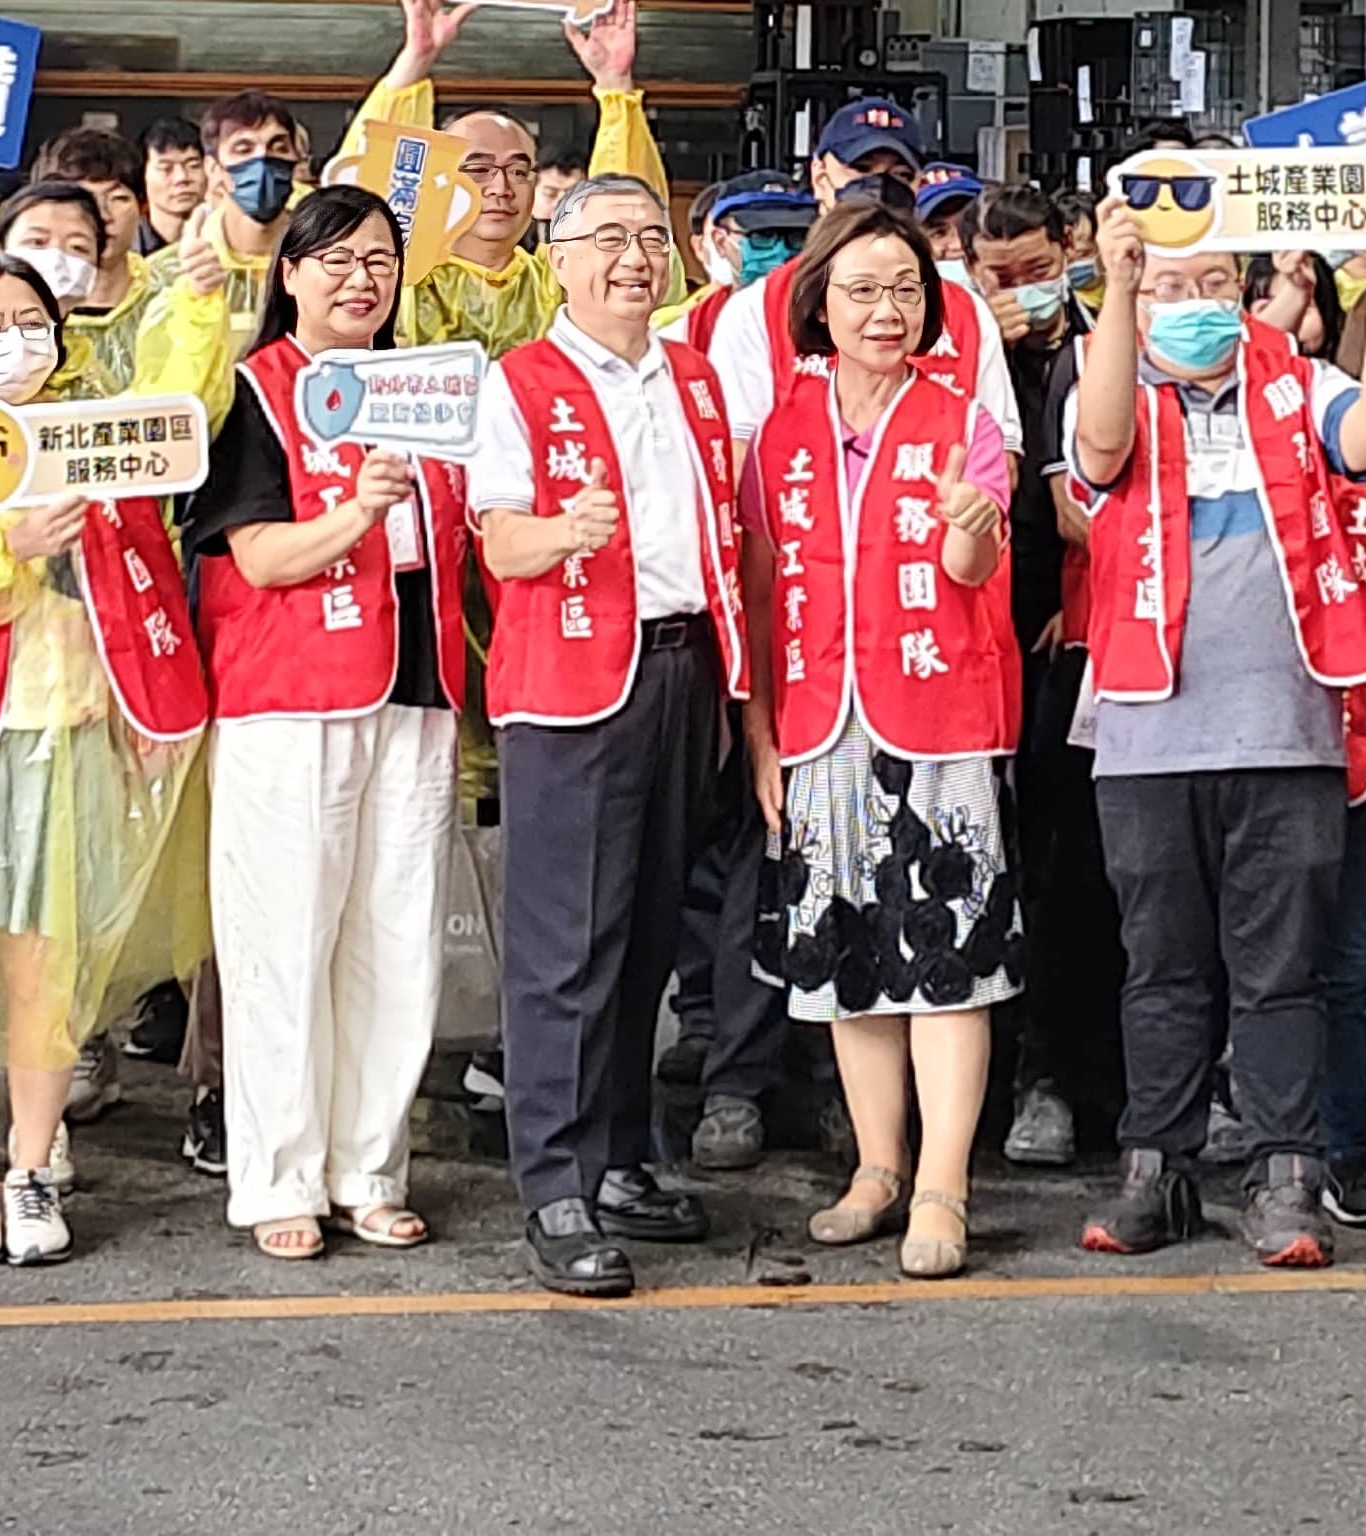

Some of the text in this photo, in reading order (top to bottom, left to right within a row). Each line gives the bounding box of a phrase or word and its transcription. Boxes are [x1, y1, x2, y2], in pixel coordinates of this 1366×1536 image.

[38, 414, 193, 452] 新北產業園區
[66, 451, 170, 485] 服務中心
[778, 448, 815, 683] 土城工業區
[891, 441, 949, 679] 服務團隊
